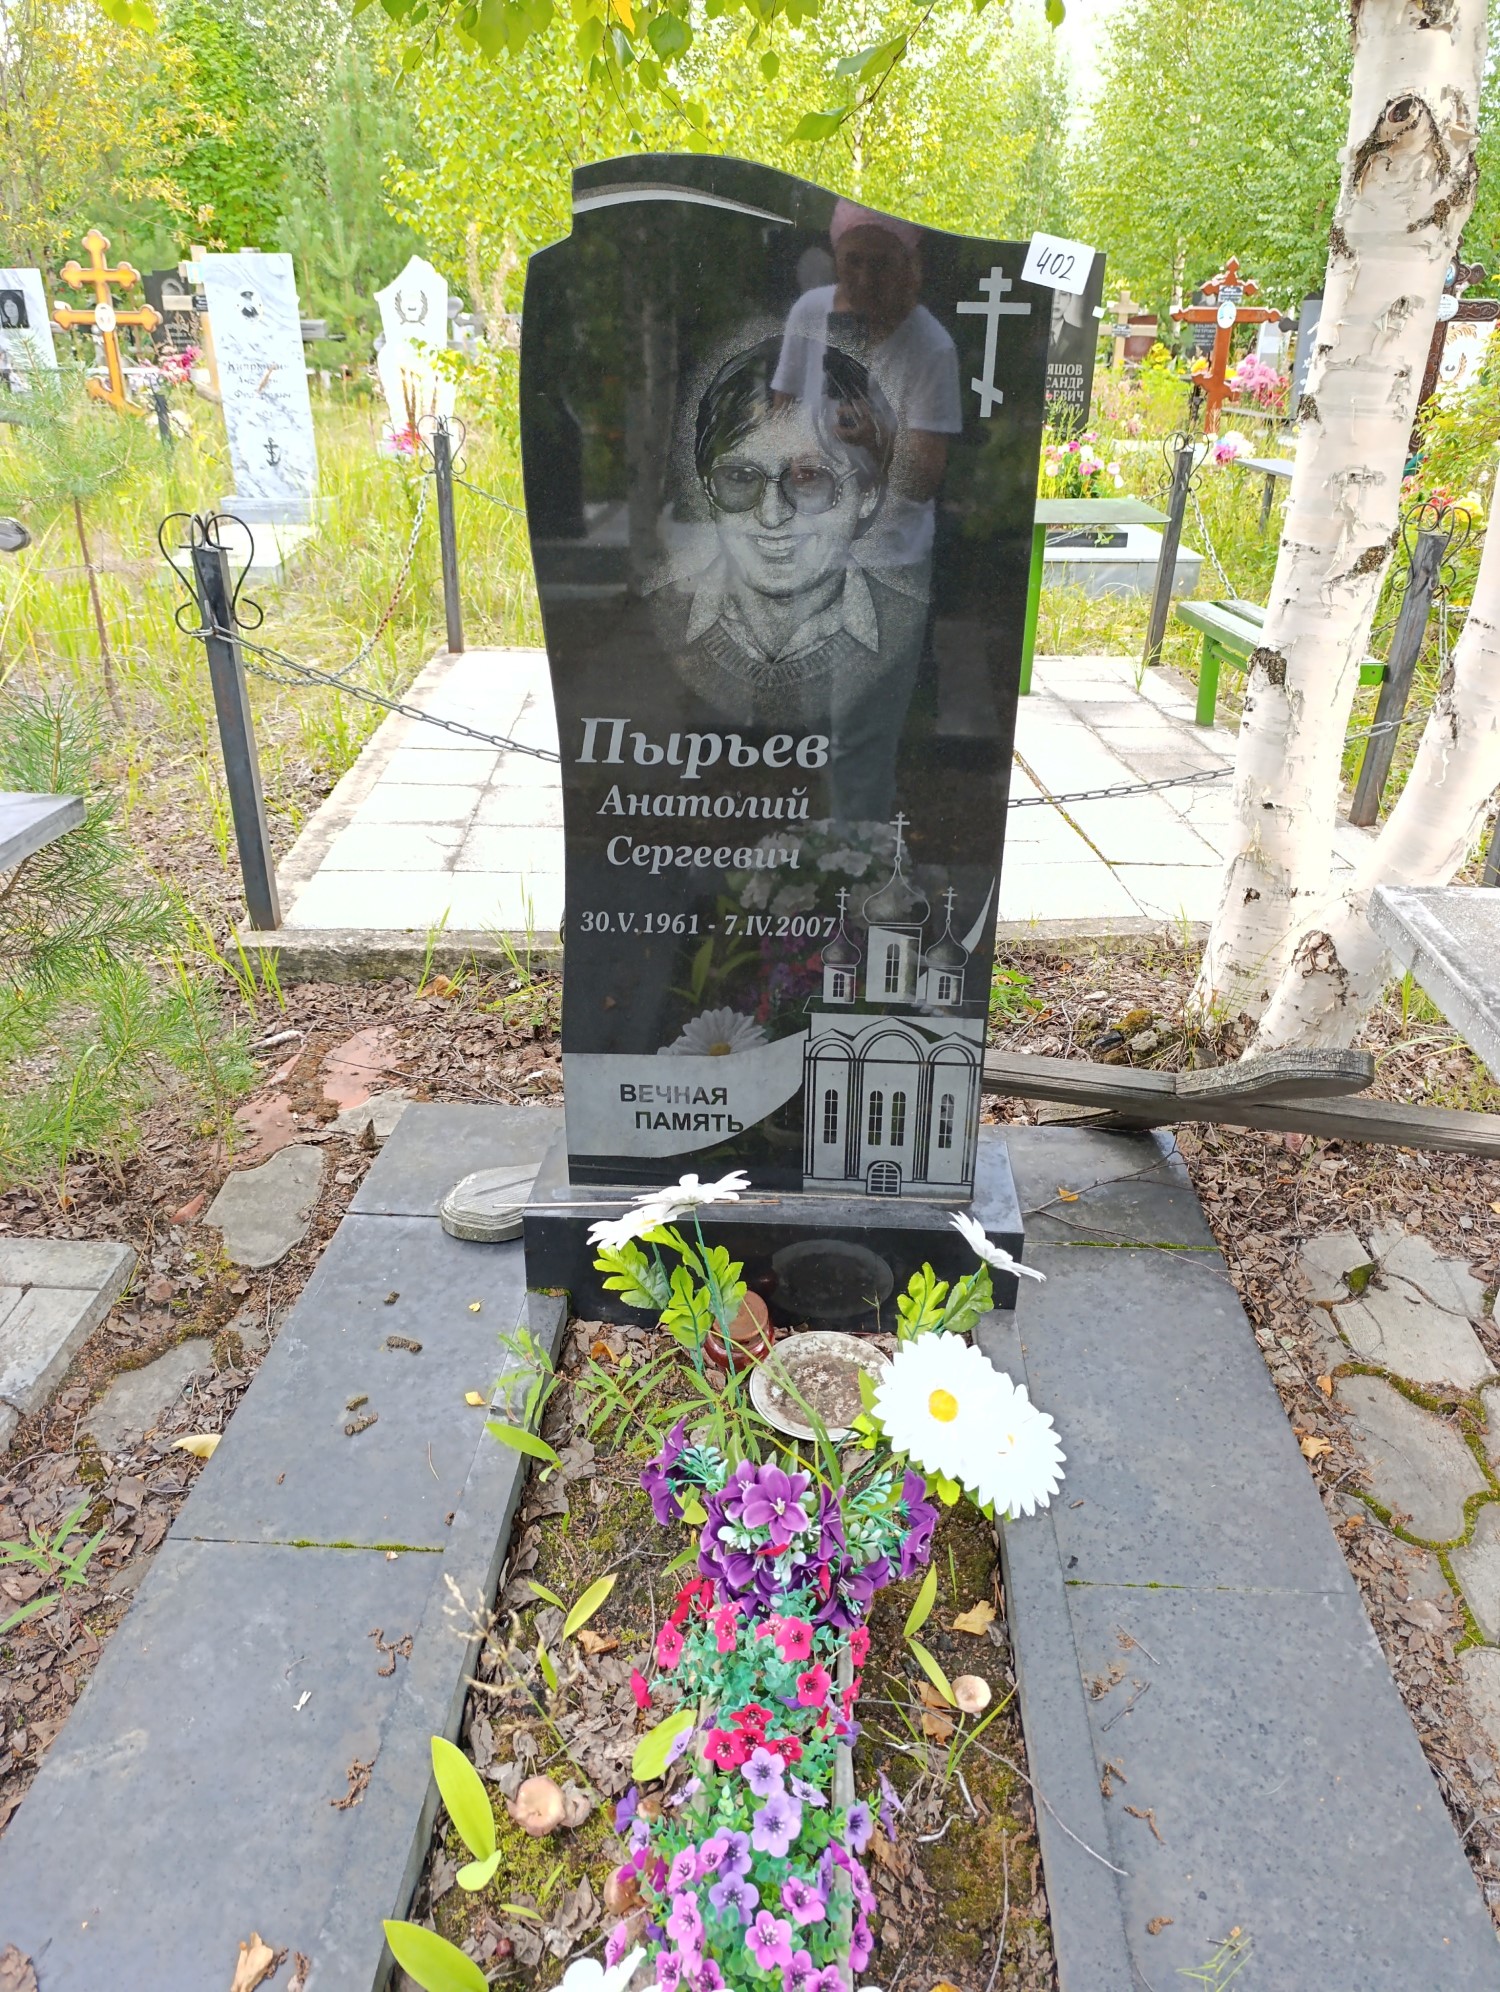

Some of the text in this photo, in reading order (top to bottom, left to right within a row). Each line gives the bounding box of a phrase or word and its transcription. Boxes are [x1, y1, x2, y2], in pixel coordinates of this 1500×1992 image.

[1036, 247, 1076, 281] 402
[575, 717, 830, 779] Пырьев
[596, 784, 810, 820] Анатолий
[606, 836, 801, 875] Сергеевич
[724, 914, 836, 938] 7.IV.2007
[620, 1083, 728, 1106] ВЕЧНАЯ
[635, 1111, 744, 1133] ПАМЯТЬ
